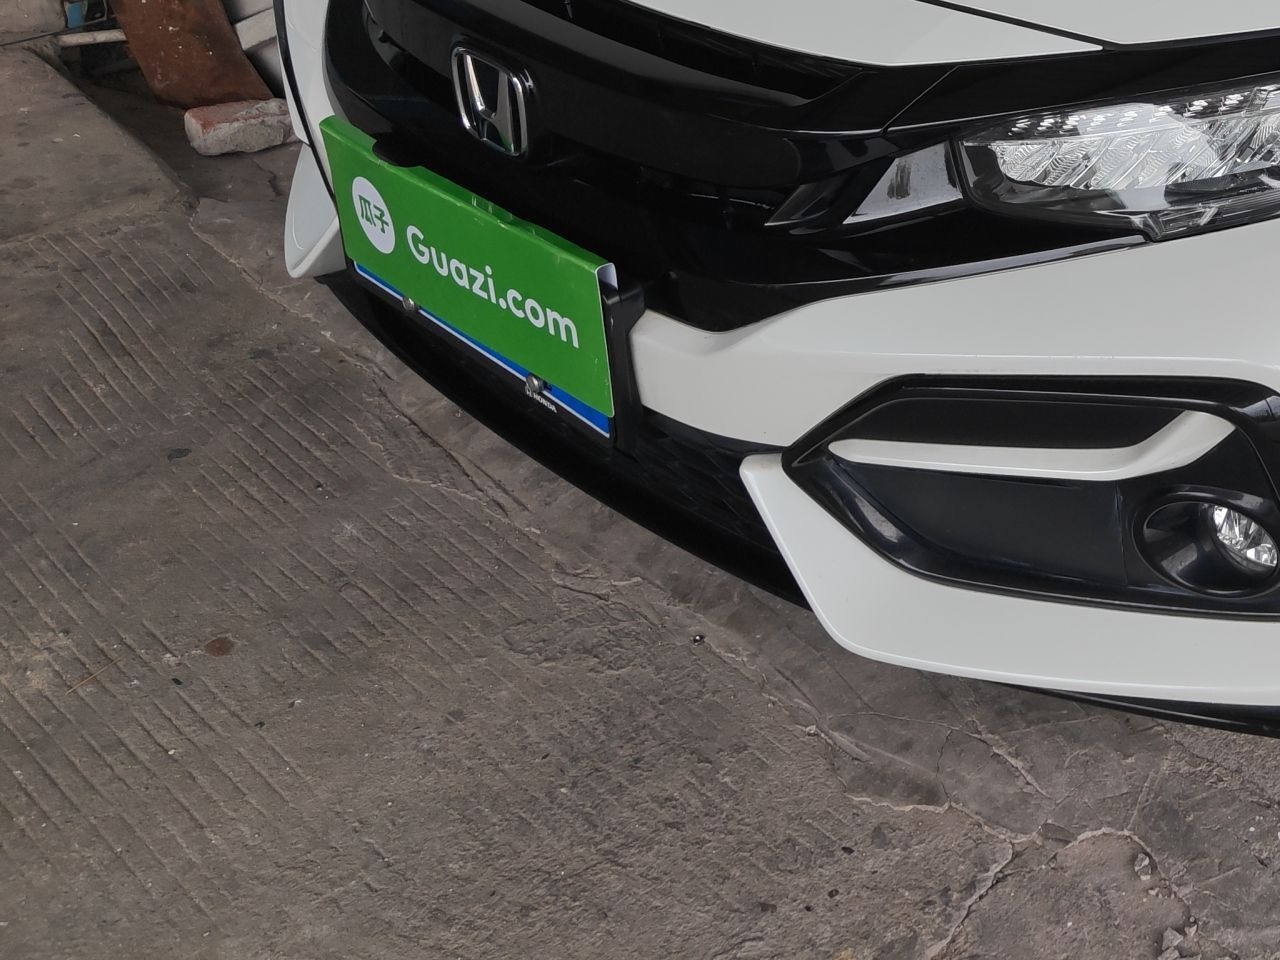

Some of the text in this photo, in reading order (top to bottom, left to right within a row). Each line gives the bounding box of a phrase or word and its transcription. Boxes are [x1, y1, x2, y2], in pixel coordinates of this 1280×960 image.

[358, 194, 390, 234] 瓜子
[406, 225, 580, 349] Guazi.com
[533, 393, 557, 413] HONDA
